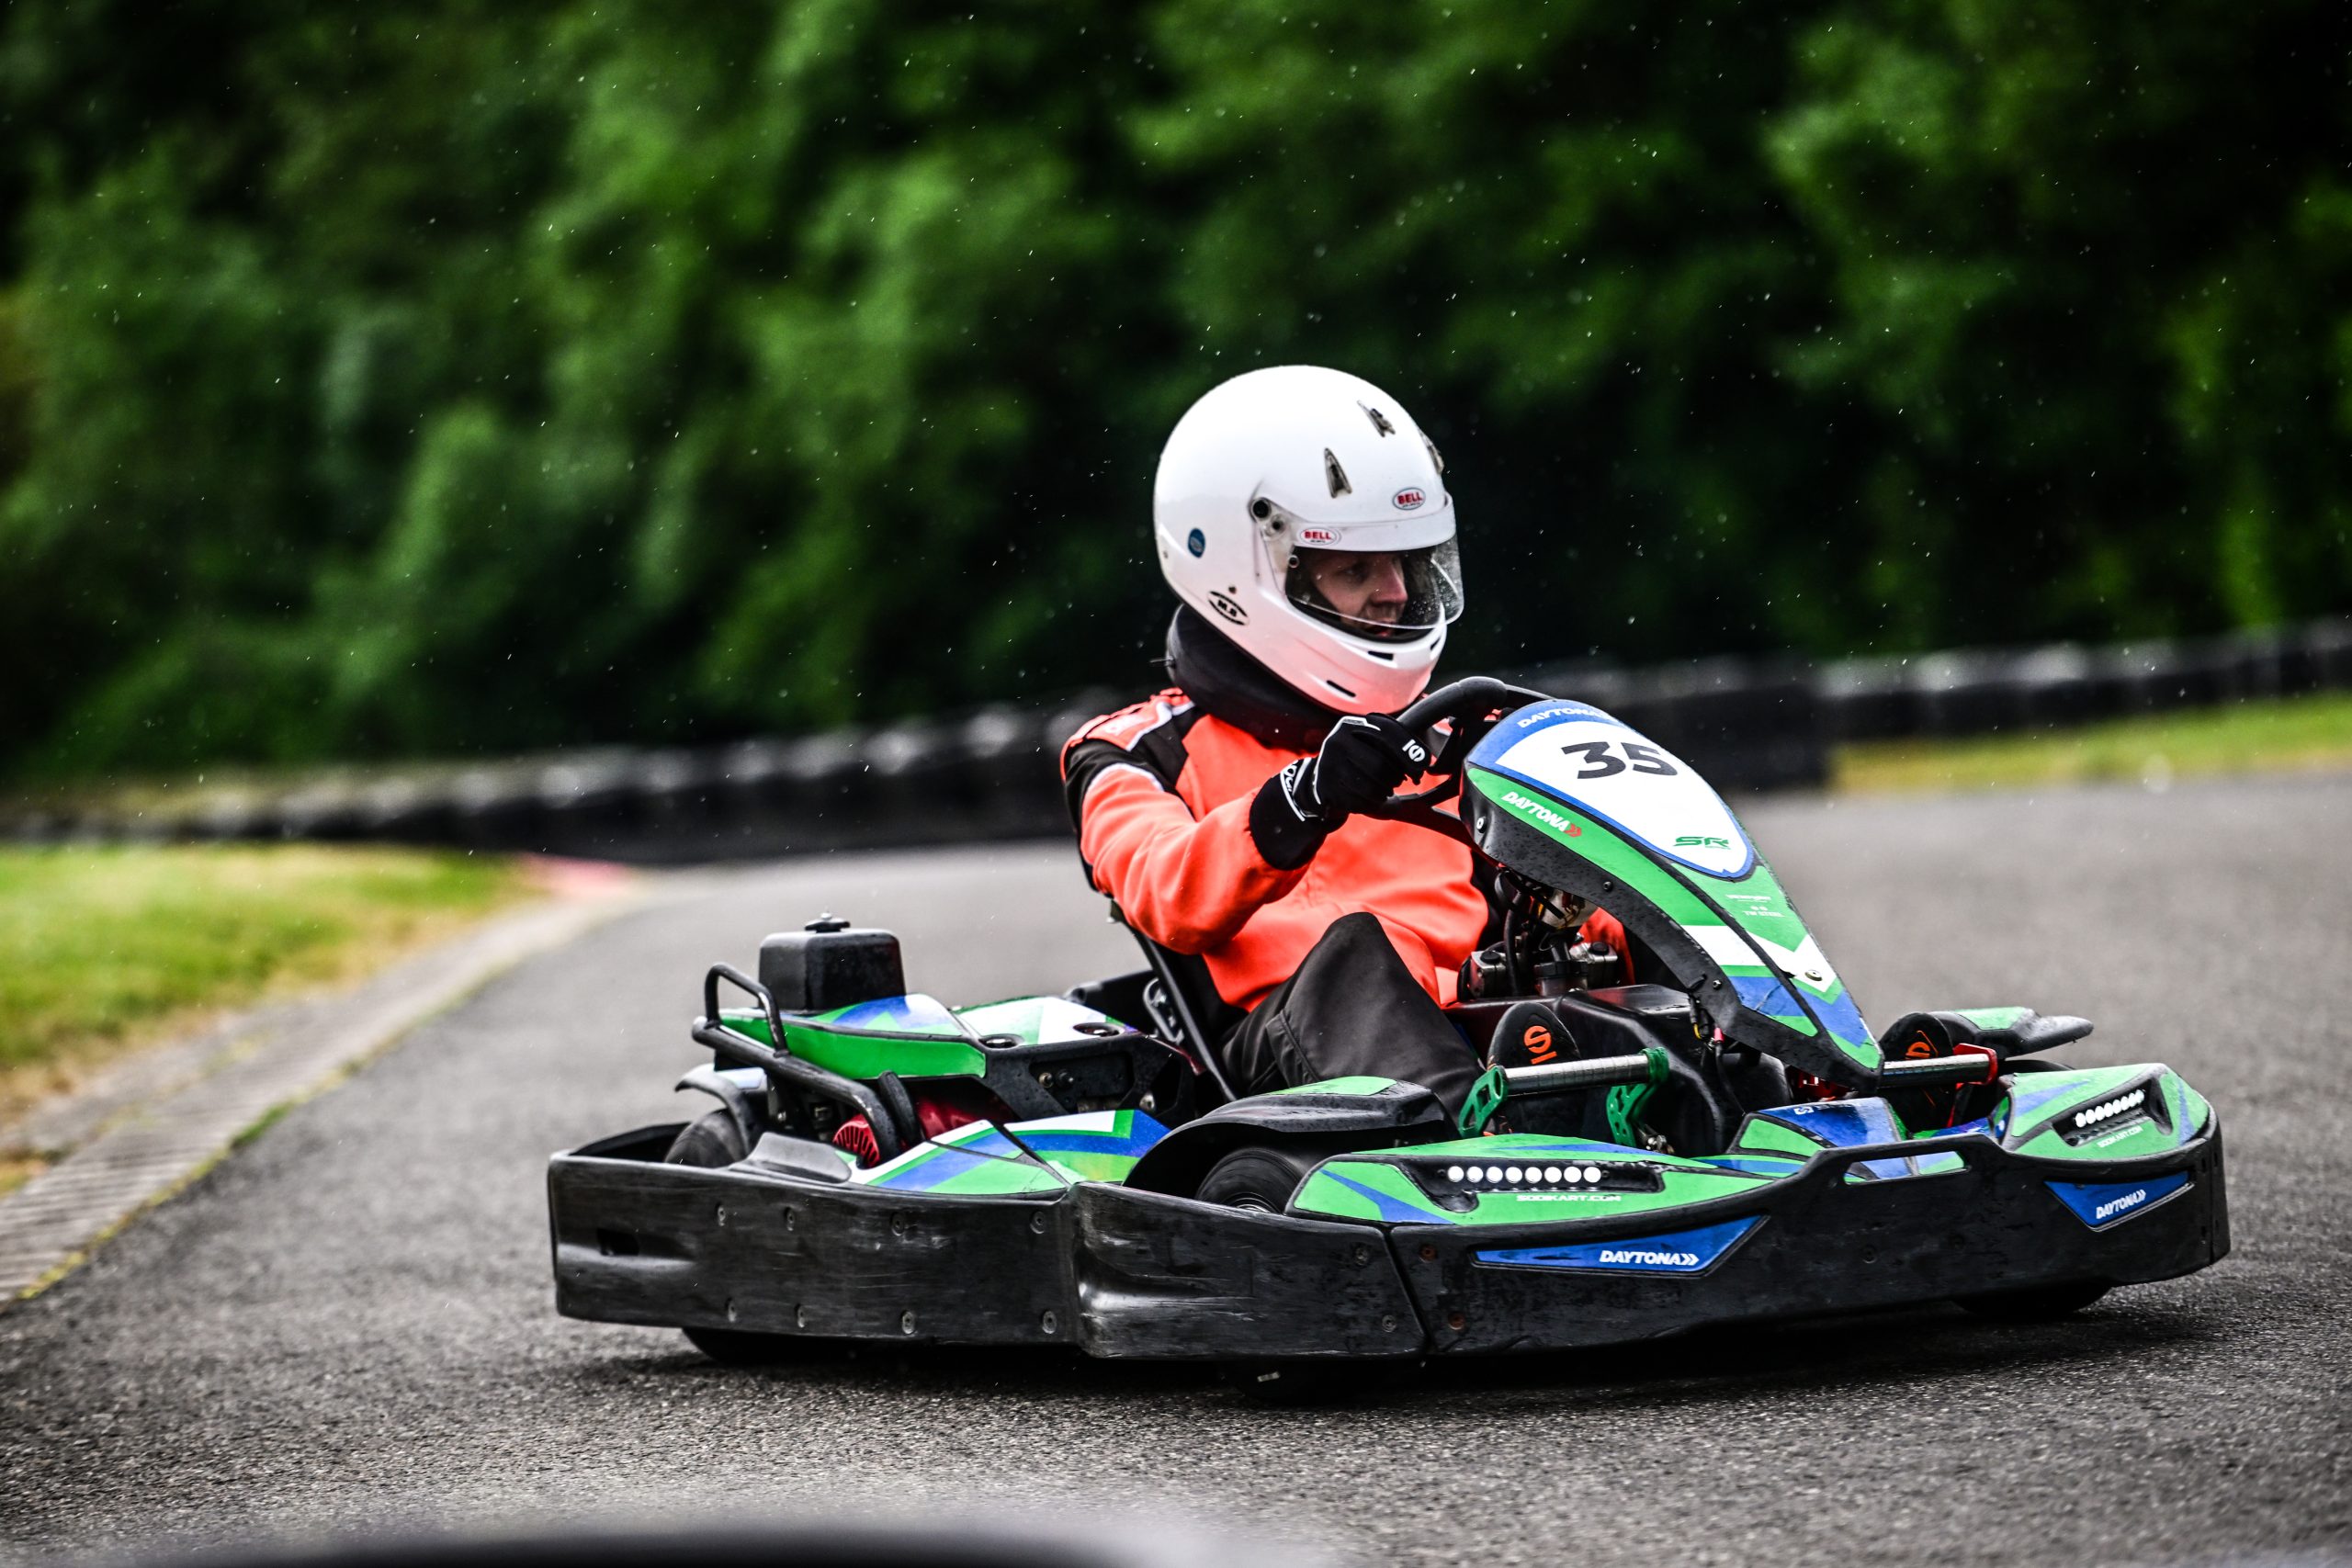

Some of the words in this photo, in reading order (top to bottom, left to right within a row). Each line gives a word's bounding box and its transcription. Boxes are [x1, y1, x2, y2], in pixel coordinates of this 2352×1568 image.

[1396, 491, 1423, 505] BELL
[1304, 531, 1331, 540] BELL
[1517, 707, 1604, 728] DAYTONA
[1560, 741, 1678, 780] 35
[1500, 791, 1570, 833] DAYTONA
[2096, 1191, 2140, 1220] DAYTONA
[1600, 1250, 1681, 1265] DAYTONA
